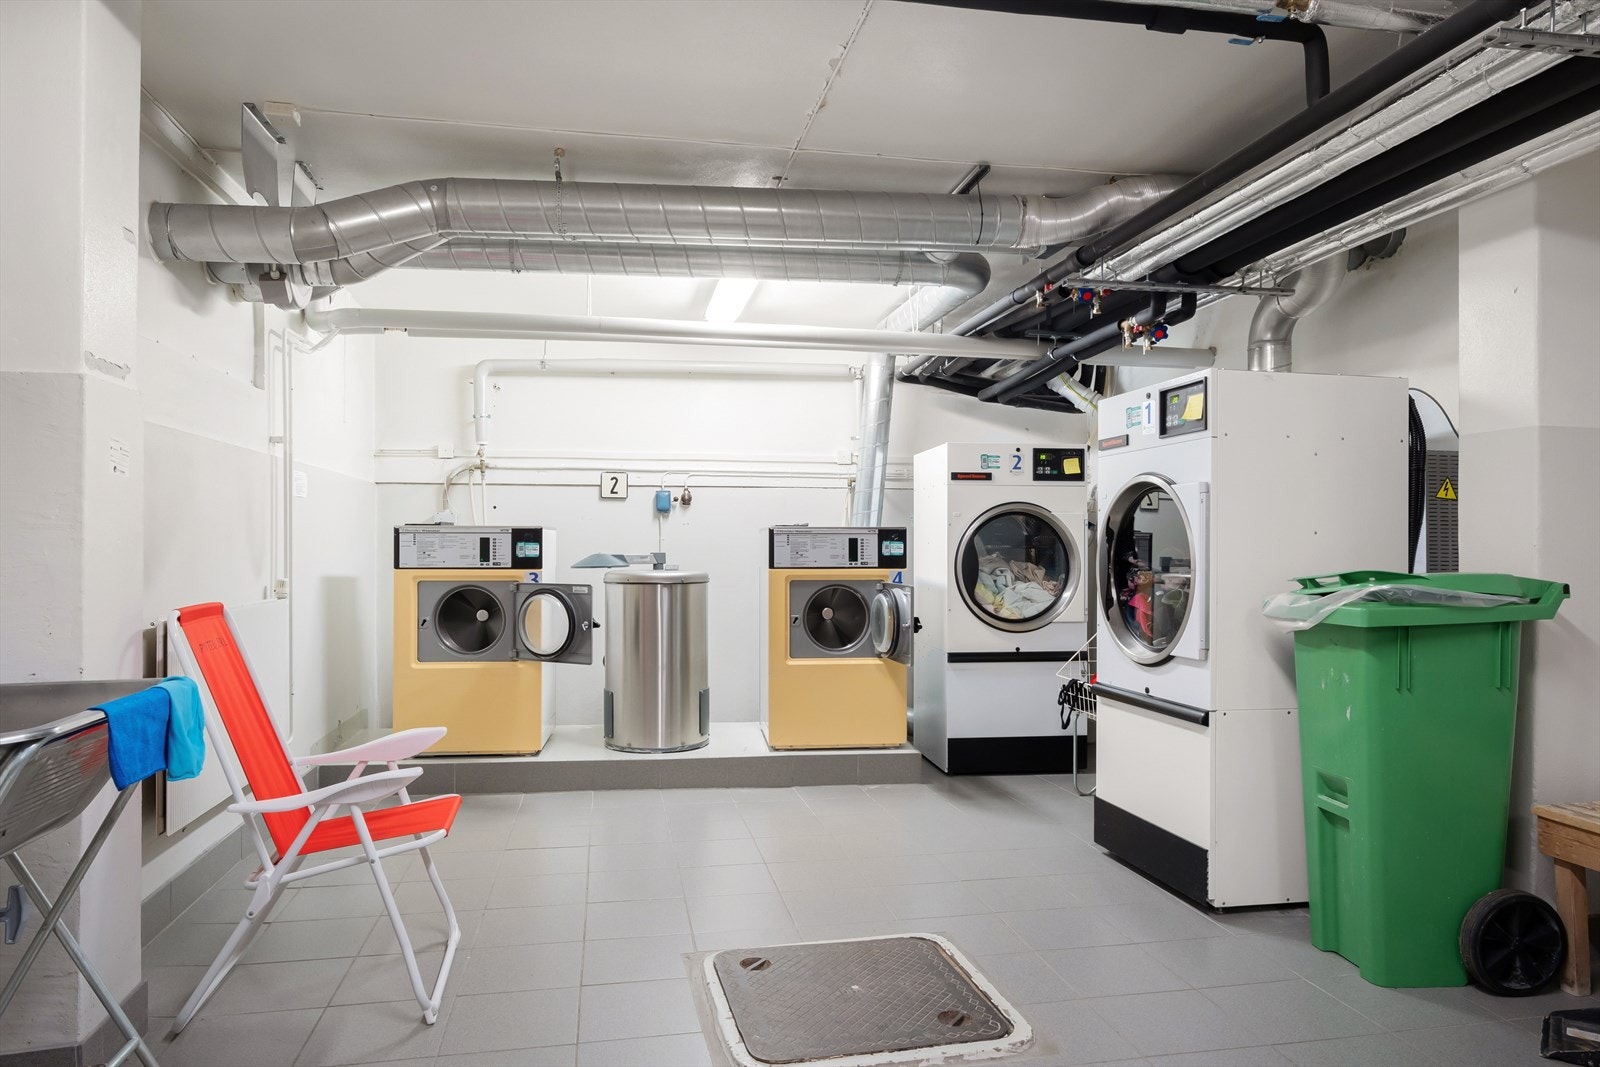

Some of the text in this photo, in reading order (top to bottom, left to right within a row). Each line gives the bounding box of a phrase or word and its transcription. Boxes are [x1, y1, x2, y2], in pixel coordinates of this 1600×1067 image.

[1145, 402, 1151, 424] 1
[1012, 454, 1022, 470] 2
[610, 476, 619, 494] 2
[528, 572, 539, 583] 3
[892, 571, 903, 584] 4
